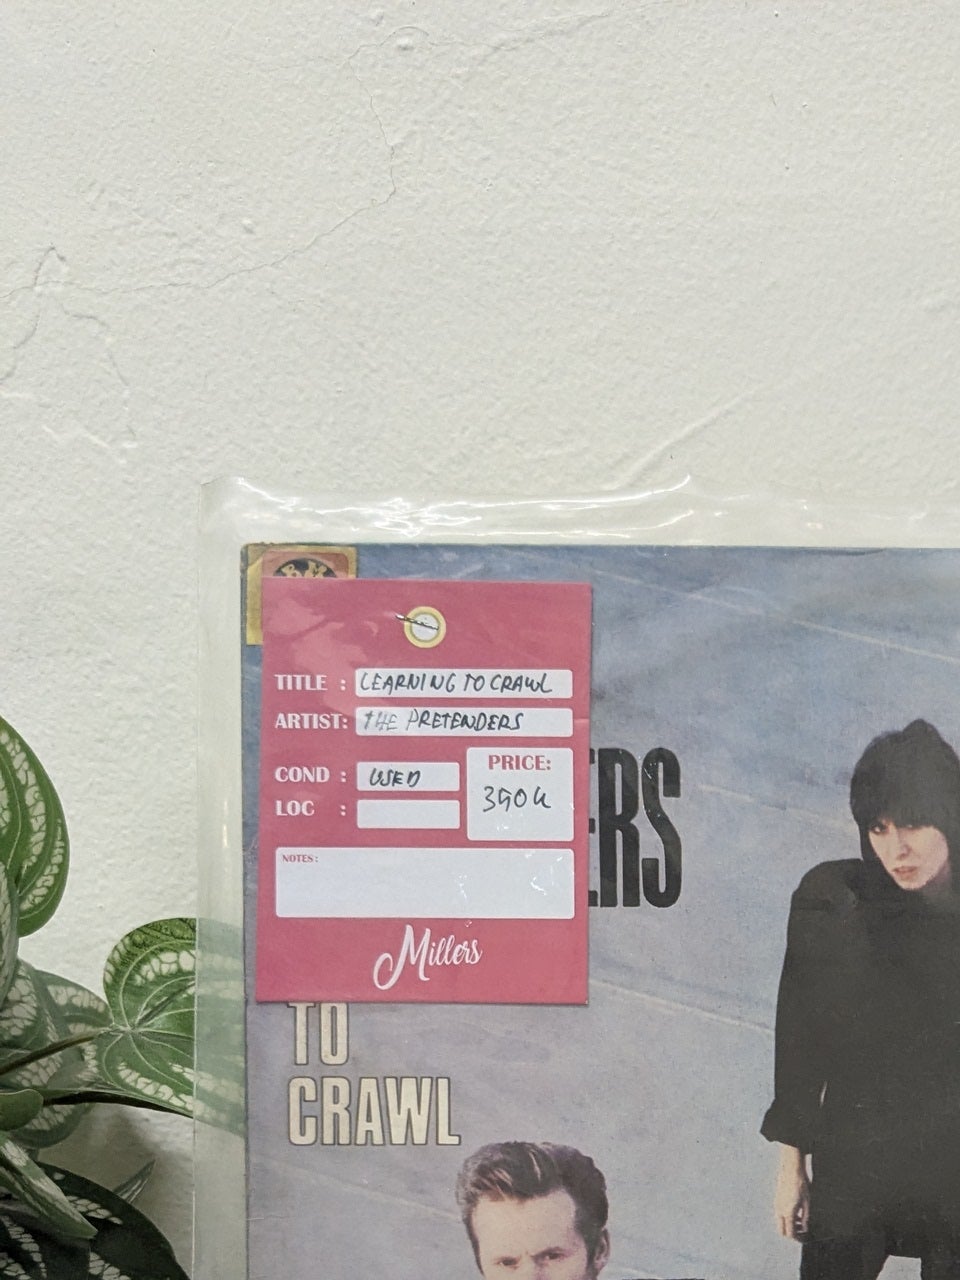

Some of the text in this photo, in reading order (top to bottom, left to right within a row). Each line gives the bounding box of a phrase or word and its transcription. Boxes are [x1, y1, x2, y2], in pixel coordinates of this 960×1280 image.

[274, 674, 328, 691] TITLE
[360, 672, 457, 695] LEARNING
[463, 673, 486, 692] TO
[274, 712, 348, 730] ARTIST:
[364, 708, 524, 732] THE PRETENDERS
[488, 754, 552, 771] PRICE:
[274, 766, 331, 784] COND
[368, 767, 422, 788] USED
[275, 799, 316, 817] LOC
[373, 924, 483, 991] Millers
[286, 1002, 349, 1066] TO
[287, 1075, 462, 1146] CRAWL
